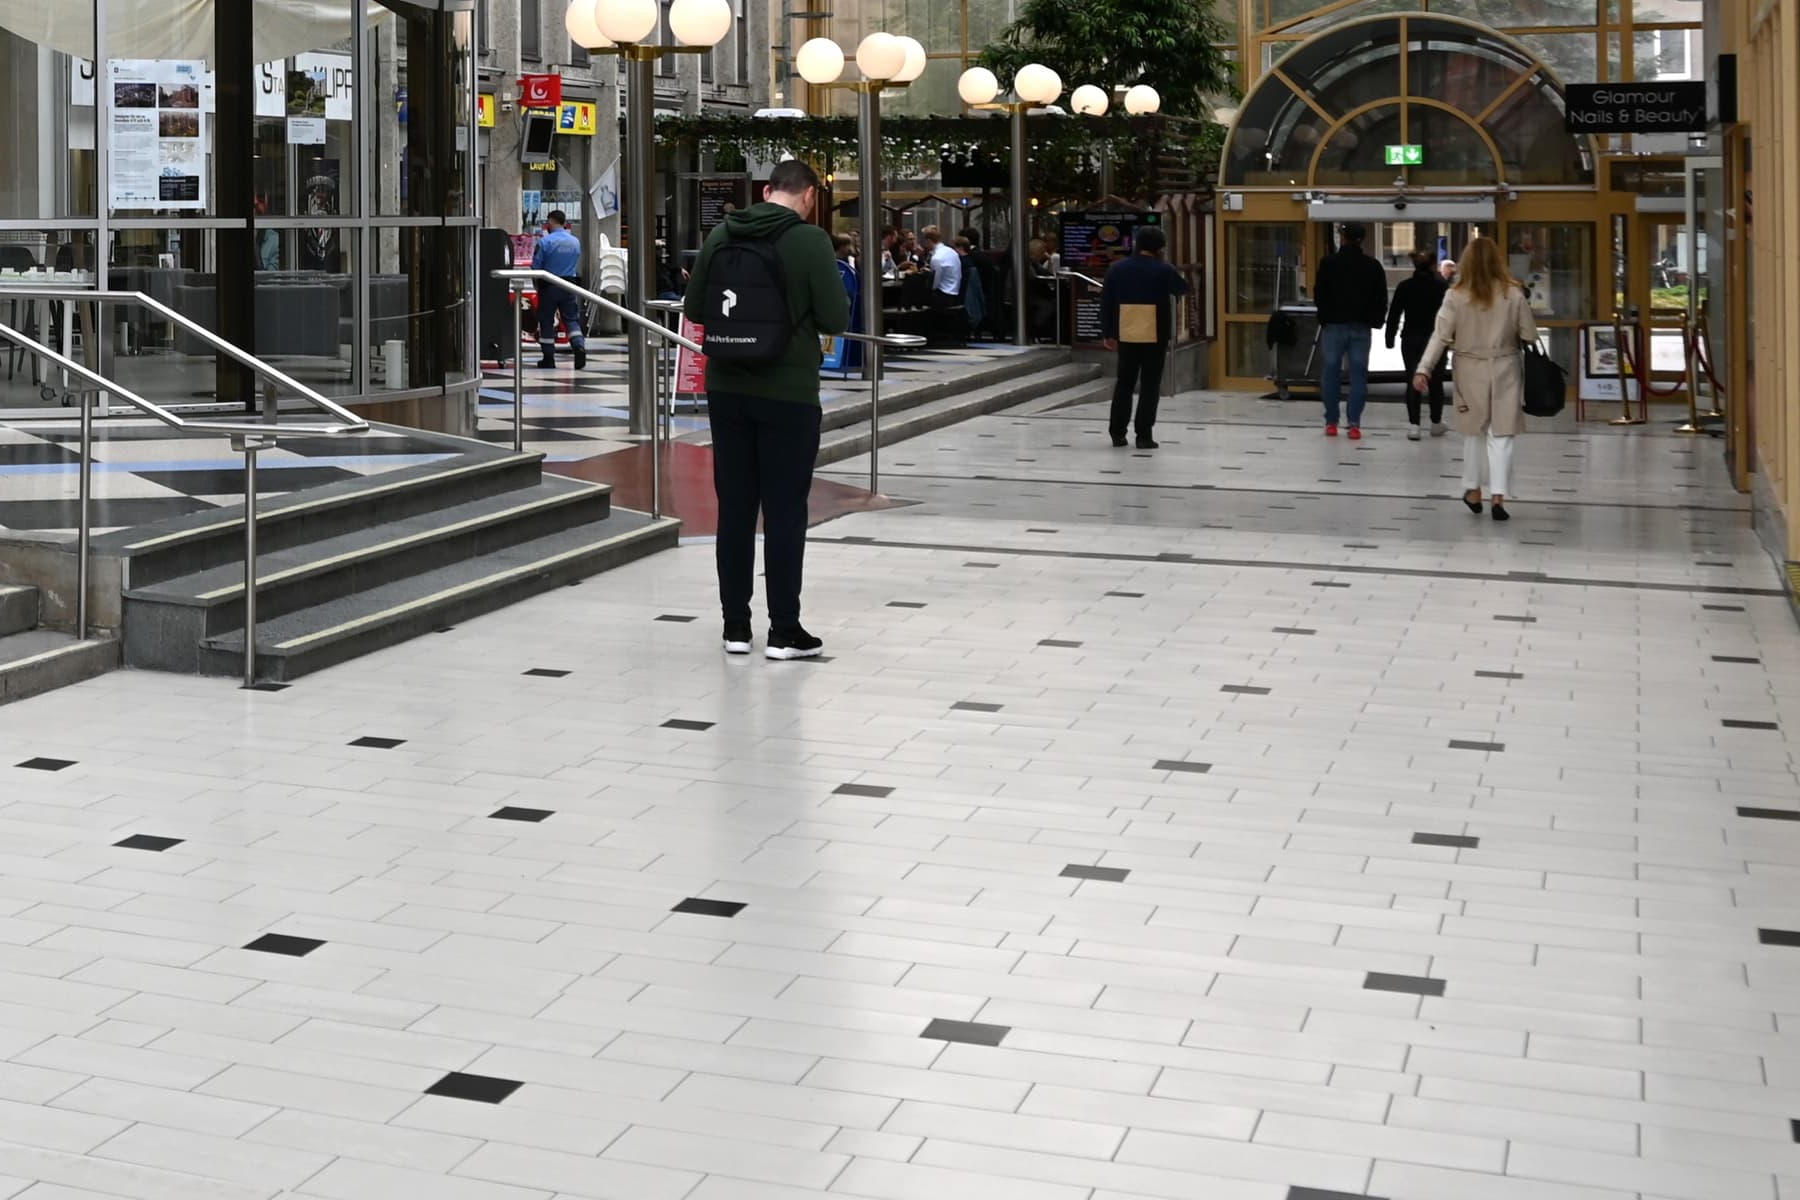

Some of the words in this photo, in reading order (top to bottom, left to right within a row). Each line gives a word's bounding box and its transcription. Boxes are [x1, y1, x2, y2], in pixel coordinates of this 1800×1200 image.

[1592, 90, 1676, 104] Glamour
[1570, 111, 1613, 124] Nails
[1618, 109, 1629, 124] &
[1635, 108, 1699, 125] Beauty
